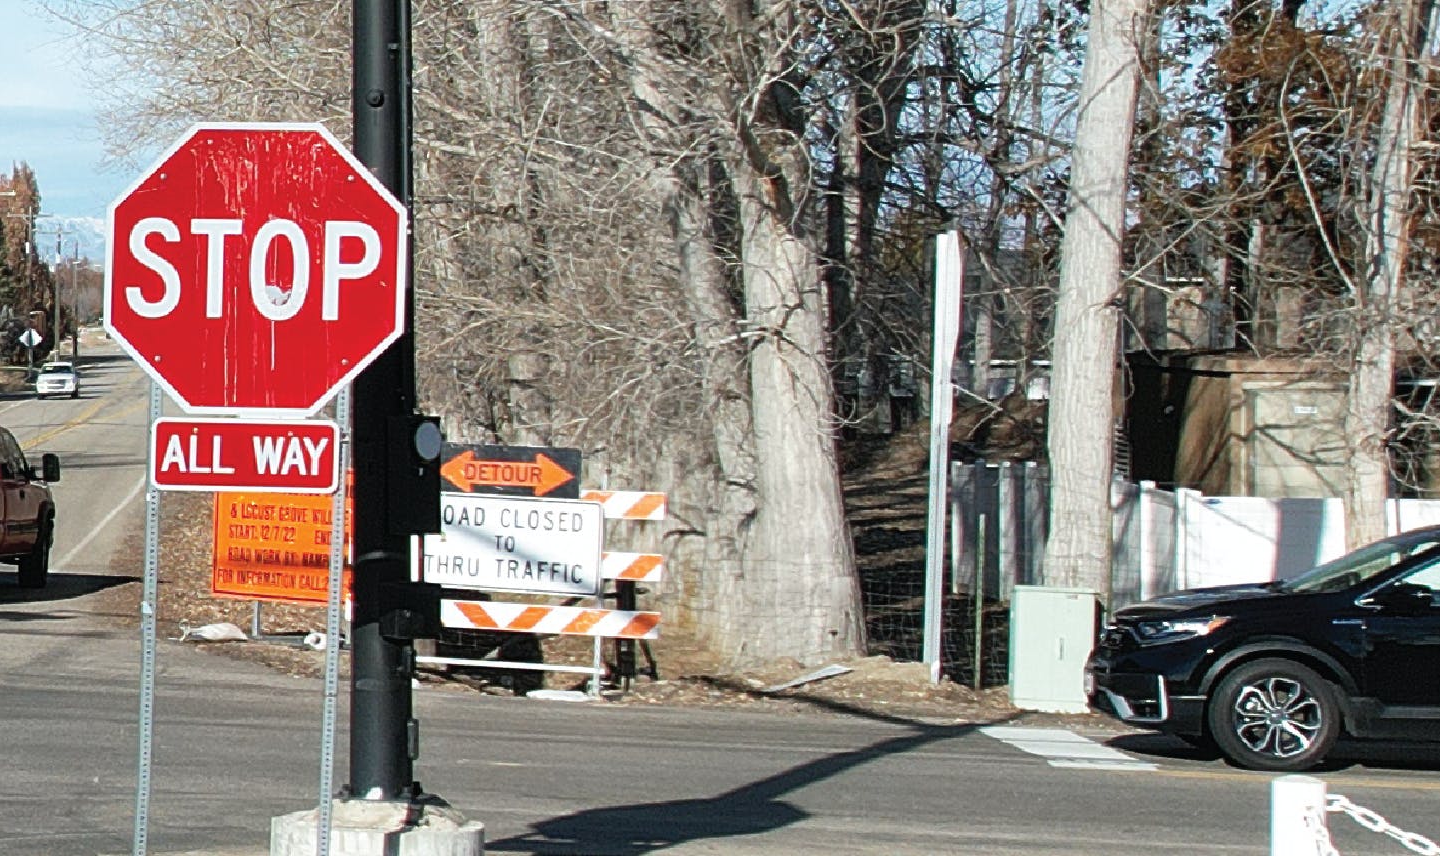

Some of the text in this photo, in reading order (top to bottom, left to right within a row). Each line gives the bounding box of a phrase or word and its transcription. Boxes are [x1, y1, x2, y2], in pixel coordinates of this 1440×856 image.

[125, 217, 382, 321] STOP
[161, 434, 328, 476] ALL WAY
[464, 463, 543, 484] DETOUR
[241, 504, 276, 521] LOCUST
[443, 504, 584, 533] OAD CLOSED
[495, 535, 516, 553] TO
[237, 570, 297, 589] INFORMATION
[424, 554, 584, 584] THRU TRAFFIC
